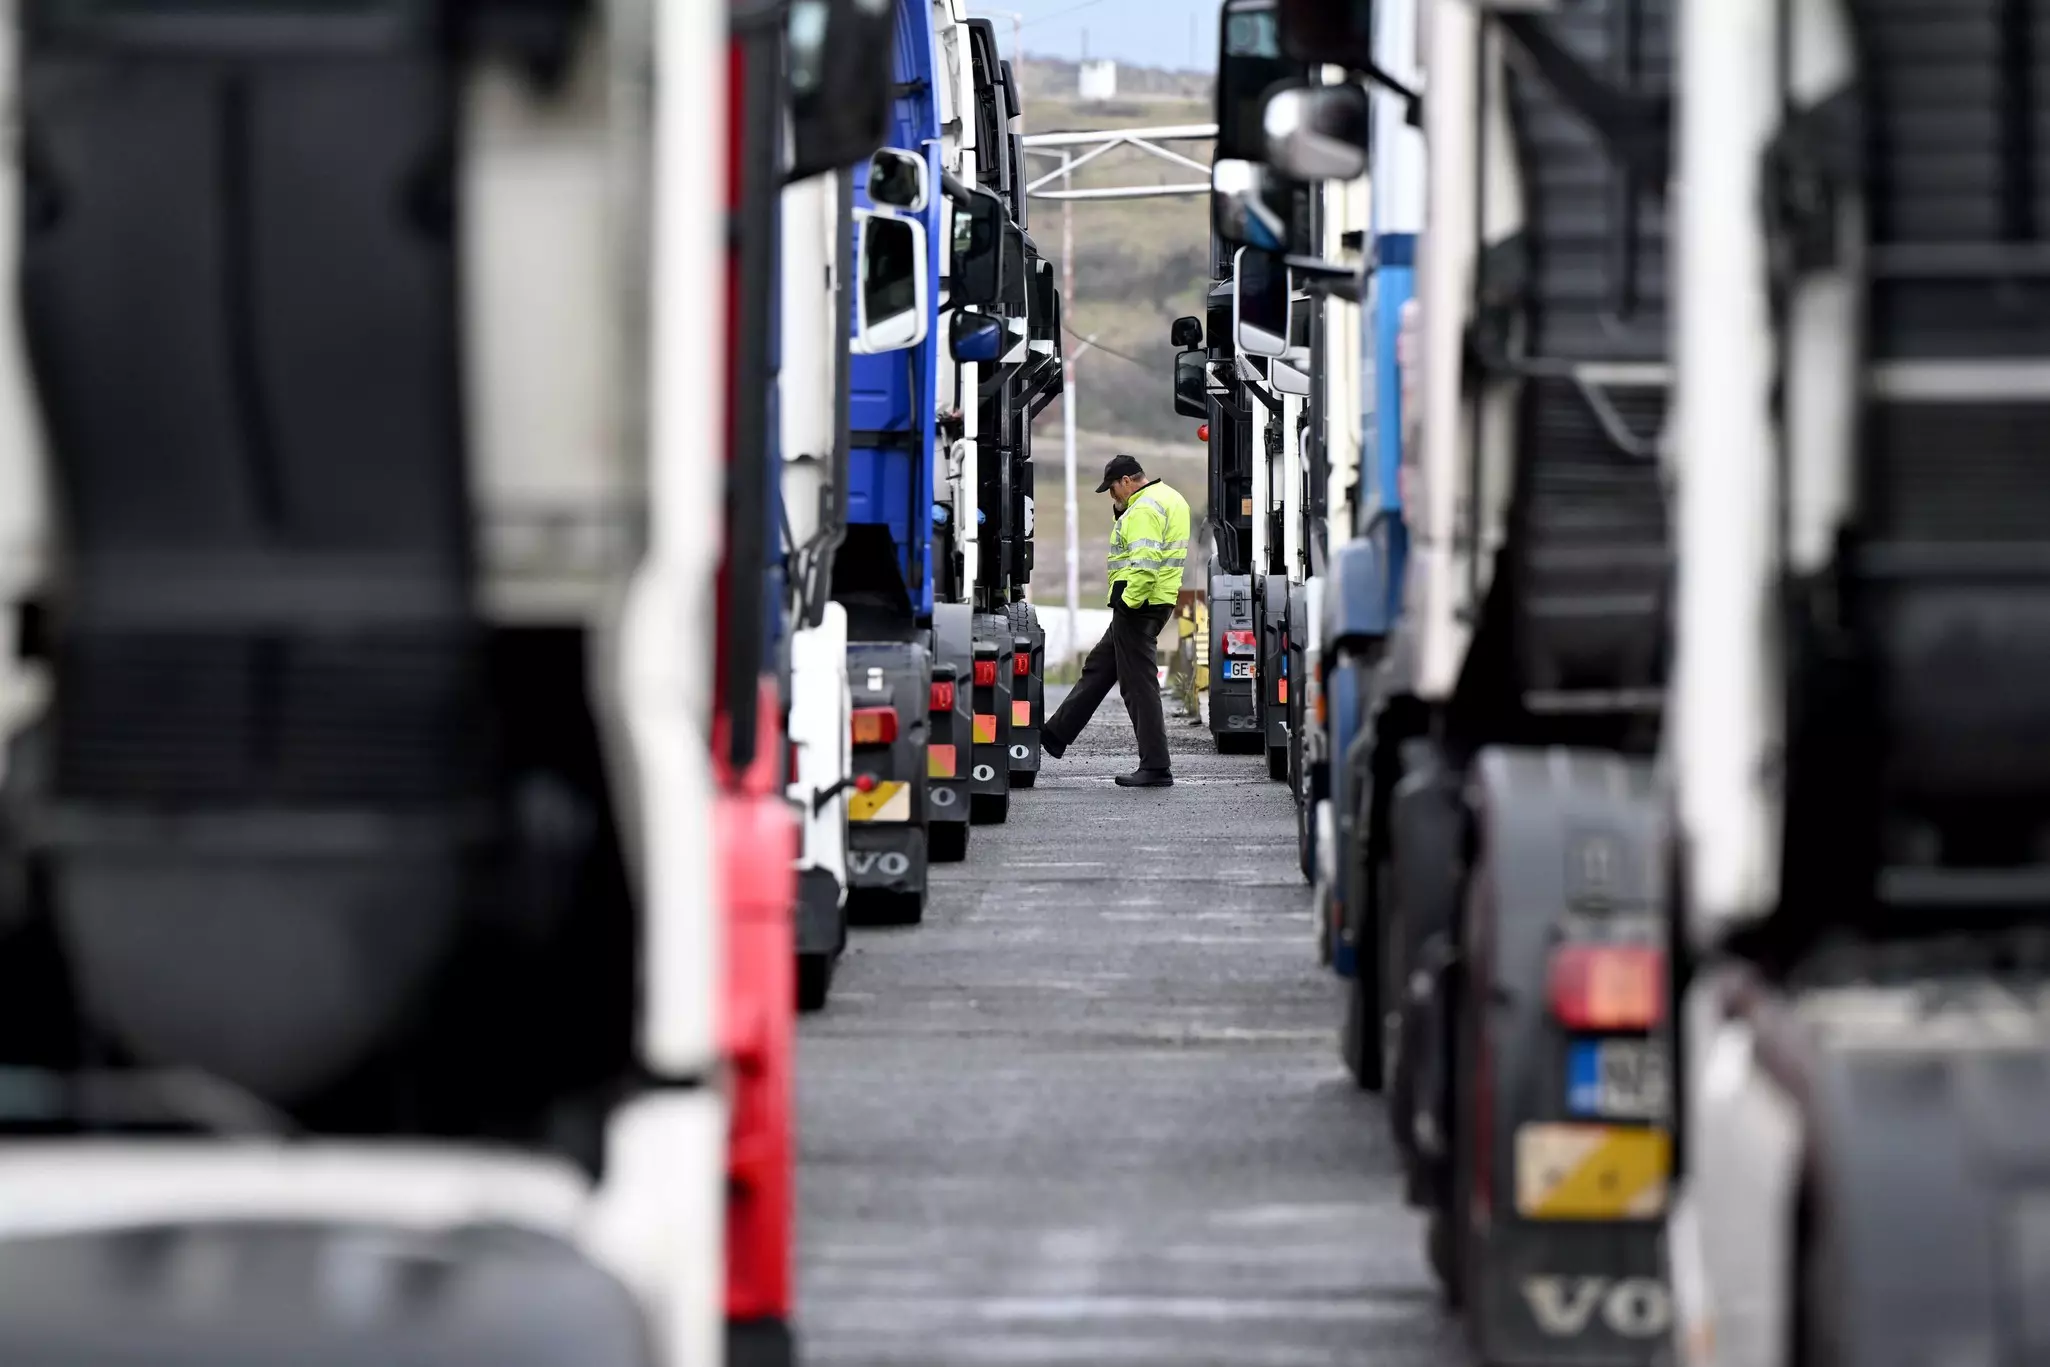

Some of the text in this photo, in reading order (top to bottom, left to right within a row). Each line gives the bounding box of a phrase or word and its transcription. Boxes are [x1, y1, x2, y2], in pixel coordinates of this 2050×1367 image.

[1232, 663, 1248, 676] GE
[1228, 715, 1257, 729] SC
[848, 852, 909, 875] VO
[1522, 1275, 1671, 1338] VO
